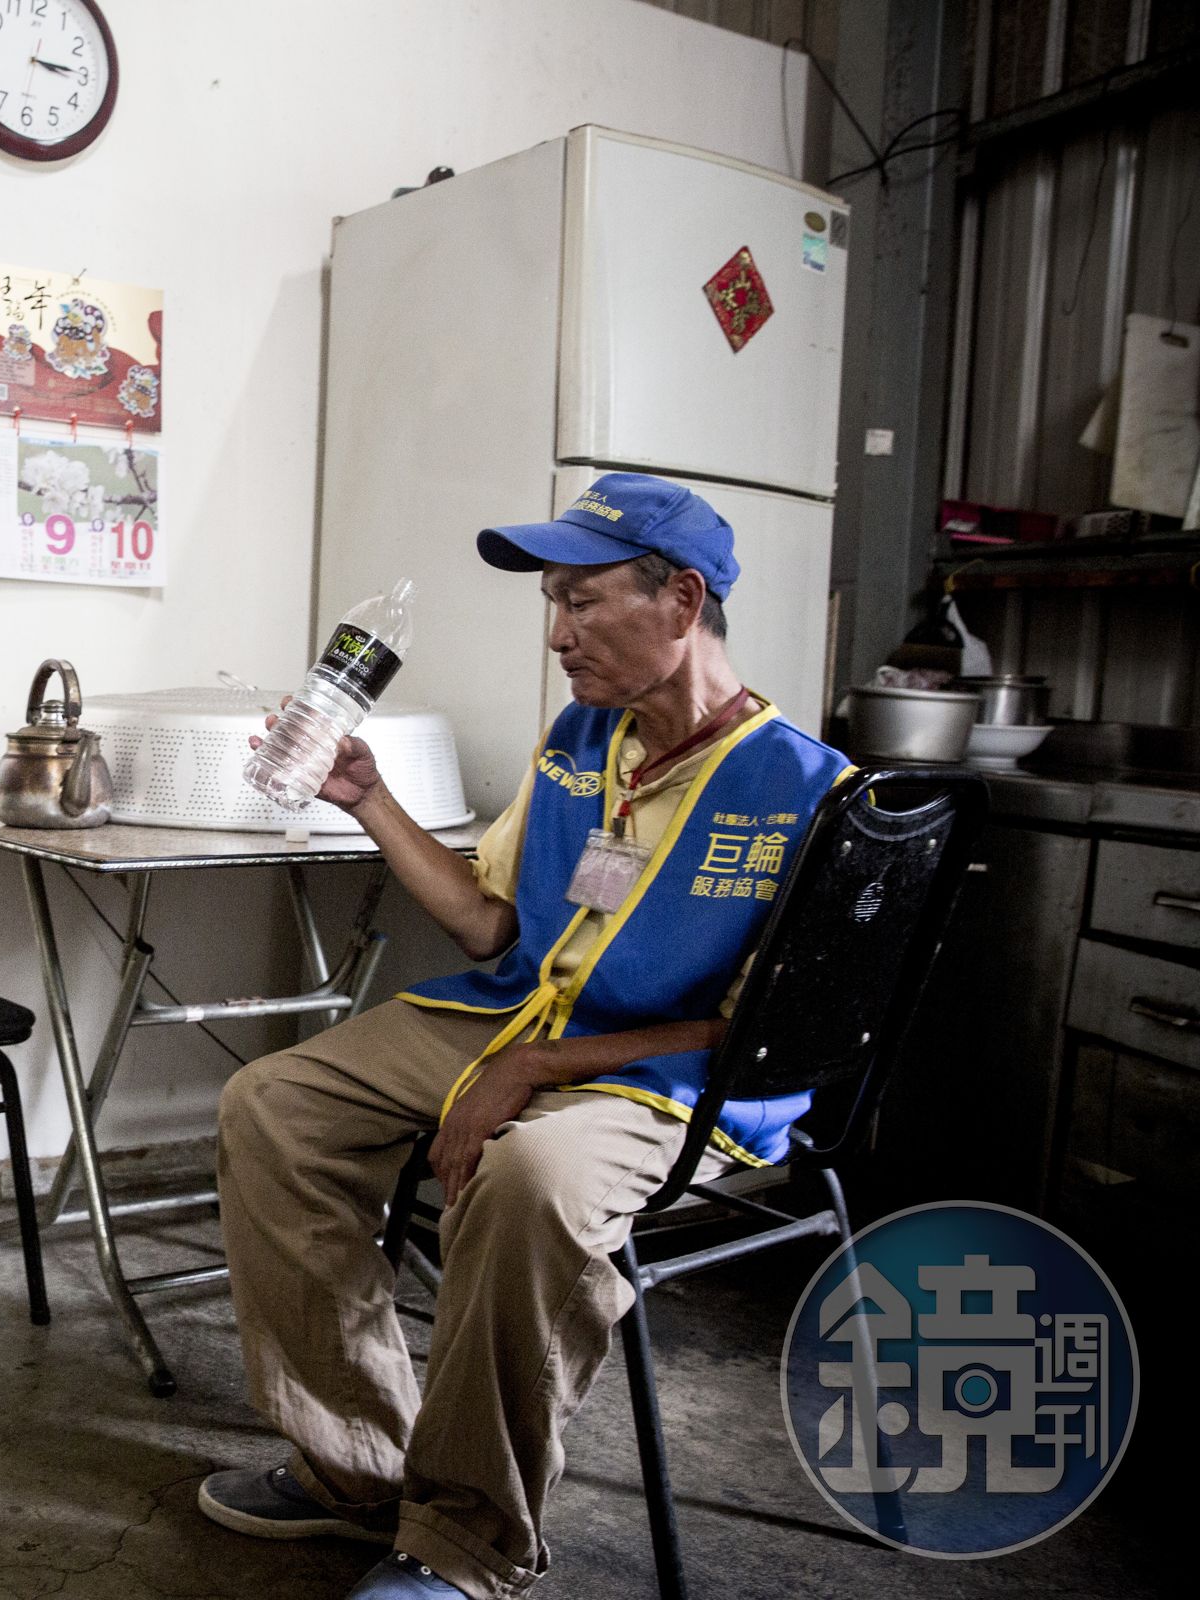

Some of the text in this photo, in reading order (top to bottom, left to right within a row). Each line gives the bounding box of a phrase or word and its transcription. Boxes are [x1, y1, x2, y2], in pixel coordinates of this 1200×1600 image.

[7, 0, 20, 17] 11
[30, 0, 49, 18] 12
[61, 11, 67, 31] 1
[72, 36, 84, 57] 2
[77, 66, 89, 86] 3
[67, 92, 79, 110] 4
[21, 106, 33, 127] 6
[47, 106, 60, 127] 5
[45, 514, 76, 555] 9
[111, 520, 154, 560] 10
[537, 757, 576, 790] NEW
[699, 832, 789, 873] 巨輪
[689, 876, 779, 901] 服務協會
